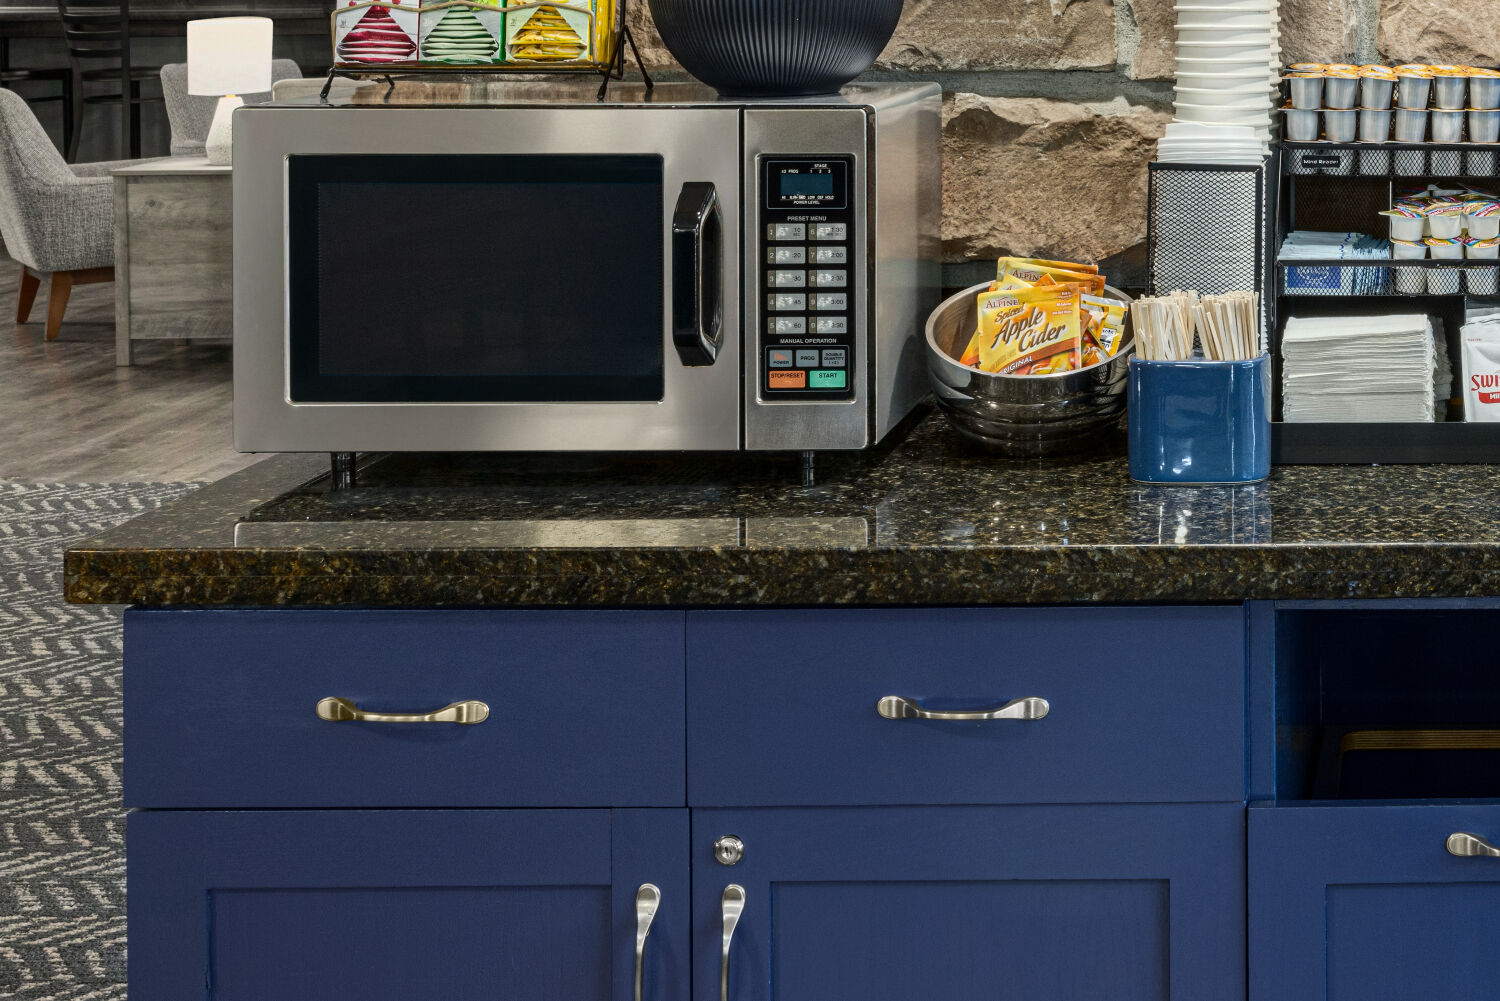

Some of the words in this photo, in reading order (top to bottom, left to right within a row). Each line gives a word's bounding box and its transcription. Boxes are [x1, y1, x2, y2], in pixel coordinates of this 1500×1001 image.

[1013, 269, 1043, 281] ALPIN
[986, 300, 1018, 309] ALPINE
[994, 302, 1025, 322] Spiced
[990, 306, 1043, 349] Apple
[1018, 322, 1066, 352] Cider
[1000, 356, 1033, 374] RIGINAL
